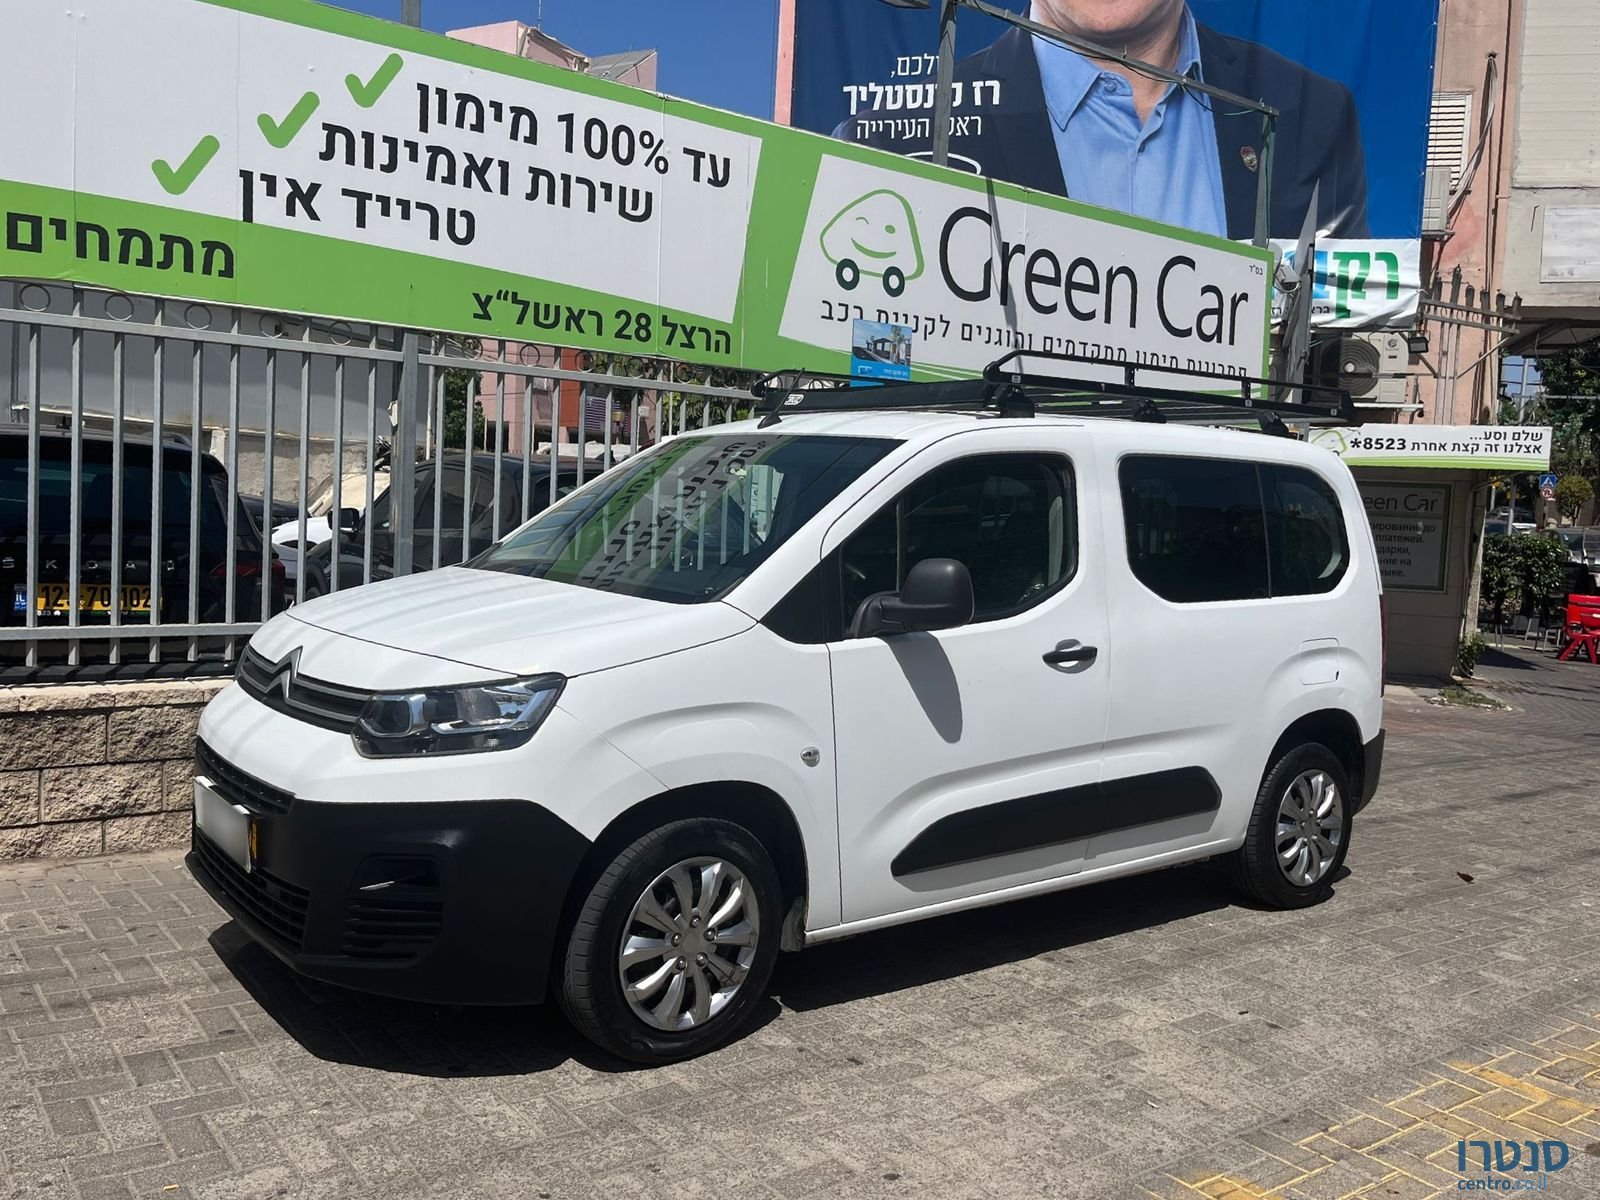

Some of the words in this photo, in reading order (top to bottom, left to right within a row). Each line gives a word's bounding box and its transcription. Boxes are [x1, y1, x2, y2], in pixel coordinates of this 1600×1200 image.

[890, 53, 940, 78] לכם,
[843, 81, 963, 116] קנסטליך
[972, 79, 1001, 106] רז
[416, 82, 538, 146] מימון
[856, 116, 930, 140] העירייה
[318, 122, 510, 196] ואמינות
[557, 112, 669, 175] 100%
[683, 146, 731, 188] עד
[239, 168, 322, 223] אין
[525, 165, 653, 223] שירות
[341, 187, 476, 246] טרייד
[6, 211, 235, 279] מתמחים
[938, 206, 1138, 329] Green
[1156, 255, 1249, 346] Car
[614, 309, 652, 343] 28
[821, 299, 864, 322] רכב
[661, 314, 732, 355] הרצל
[1410, 442, 1448, 452] אחרת
[1451, 442, 1481, 455] קצת
[1469, 431, 1507, 441] וסע...
[1484, 443, 1500, 453] זה
[1503, 442, 1543, 454] אצלנו
[1511, 429, 1543, 442] שלם
[1362, 495, 1398, 510] een
[1403, 493, 1439, 512] Car
